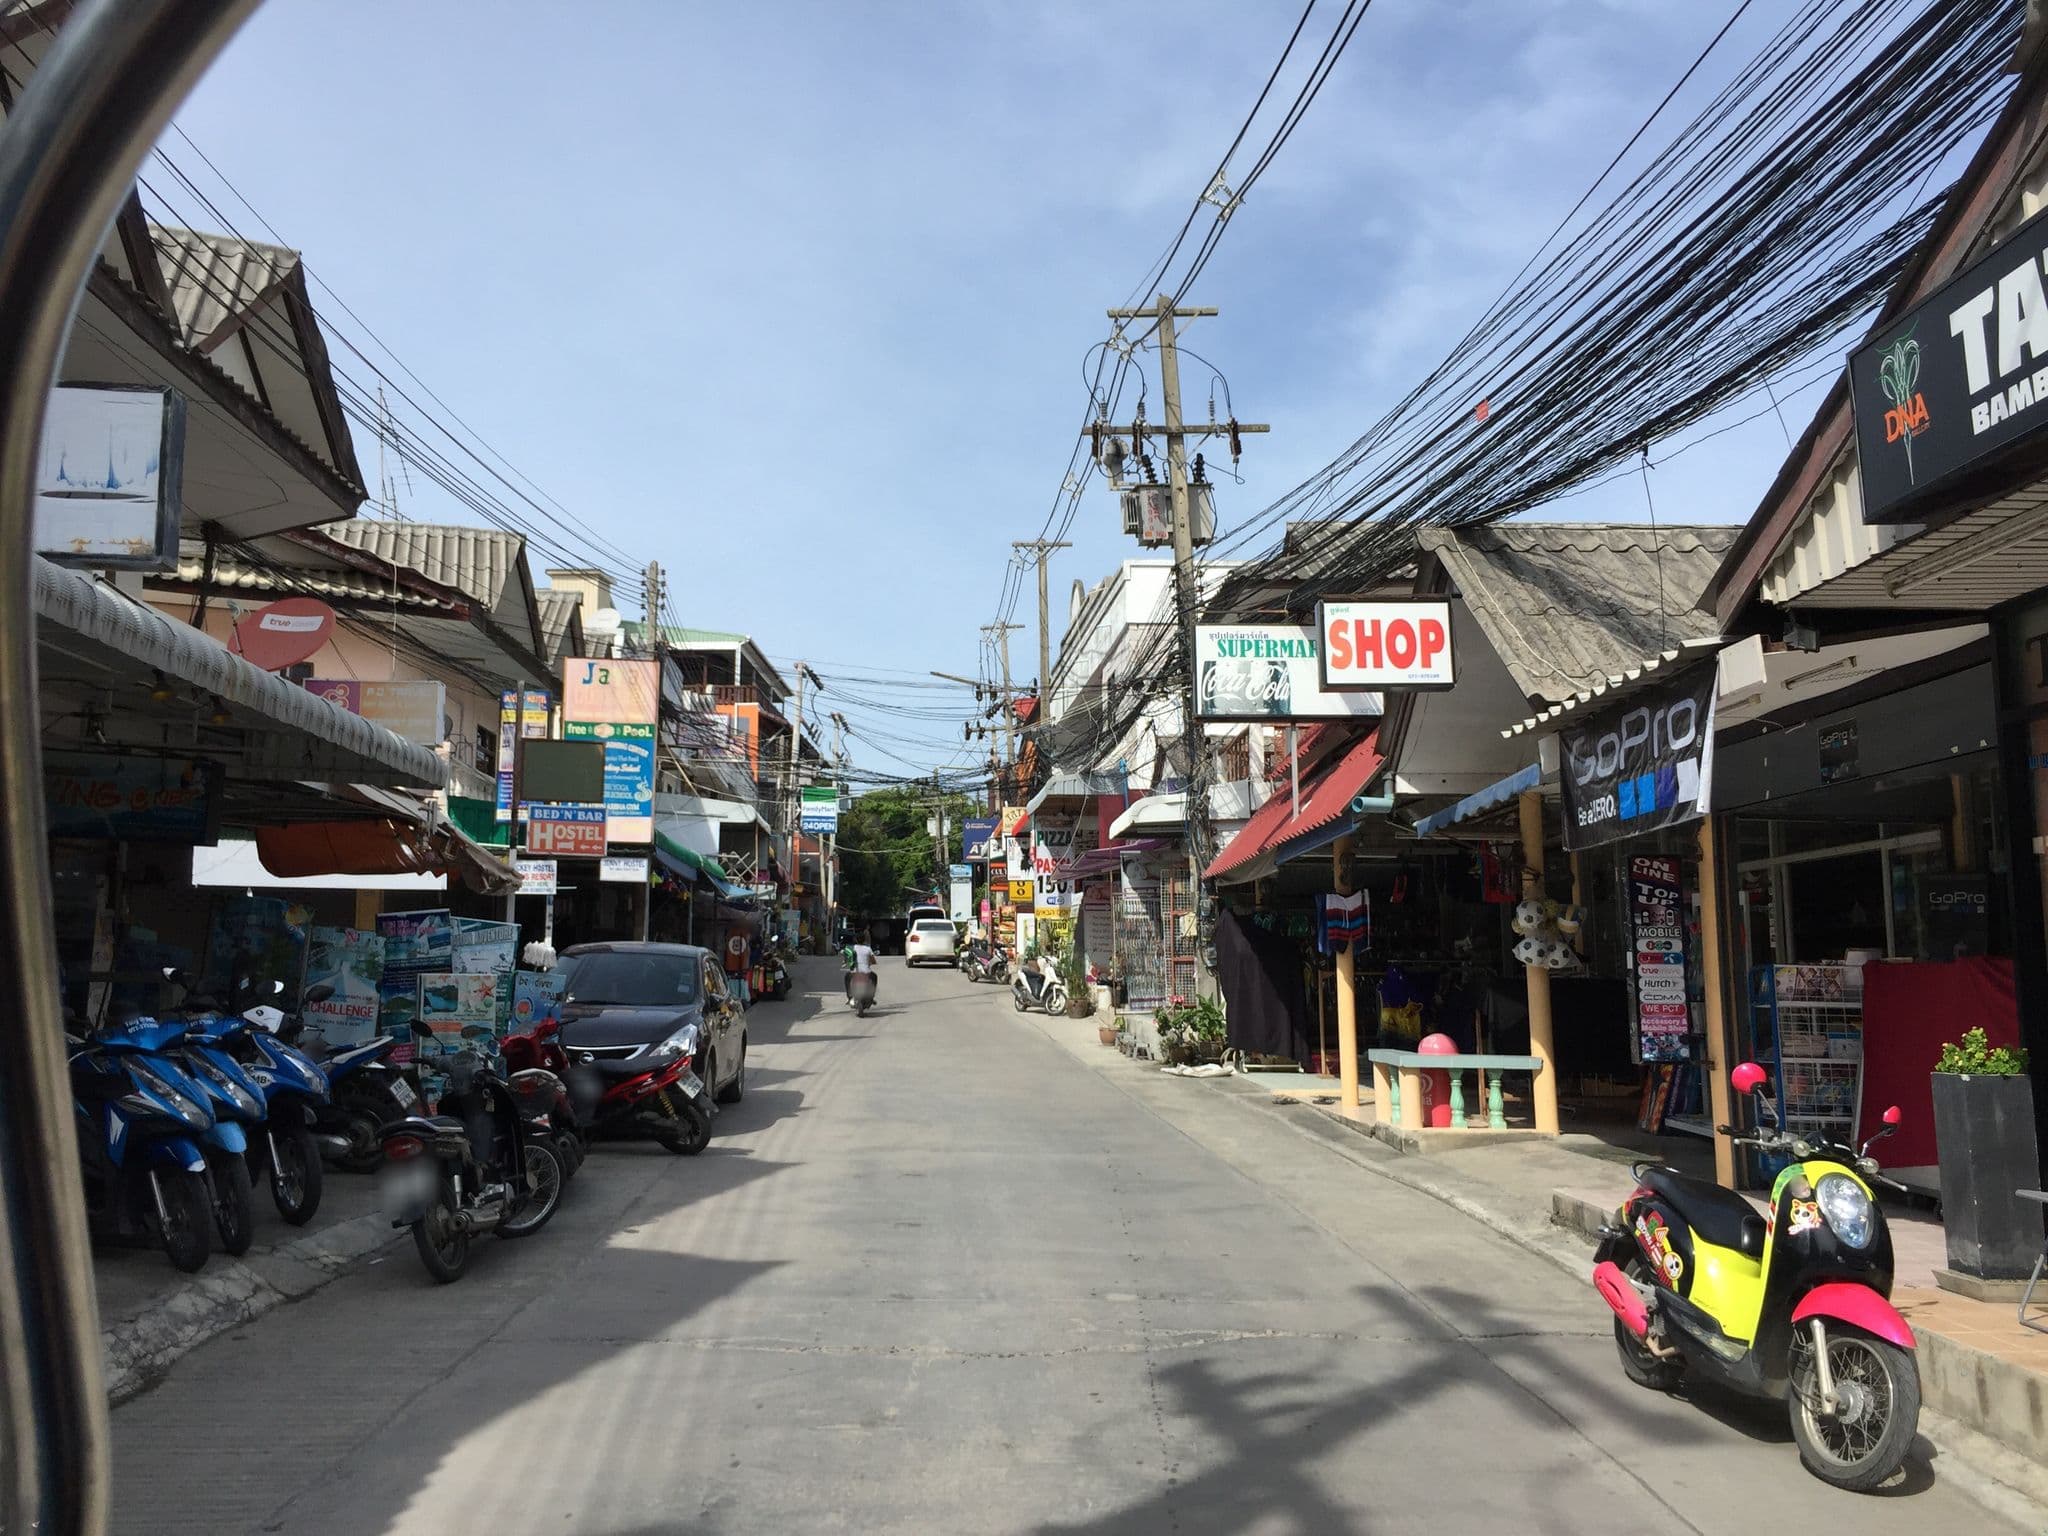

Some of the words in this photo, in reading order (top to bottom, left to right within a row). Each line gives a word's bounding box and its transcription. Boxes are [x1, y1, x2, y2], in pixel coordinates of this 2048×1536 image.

[1949, 248, 2048, 395] TA
[1971, 366, 2048, 436] BAMB
[1884, 393, 1930, 443] DNA
[1329, 619, 1445, 669] SHOP
[567, 723, 587, 736] free
[1819, 730, 1848, 746] GoPro
[1569, 698, 1698, 786] GoPro
[533, 822, 604, 850] HOSTEL
[1036, 830, 1073, 847] PIZZA
[1632, 864, 1675, 882] LINE
[1634, 857, 1670, 872] ON
[1635, 882, 1679, 899] TOP
[1929, 891, 1986, 904] GoPro
[1638, 895, 1674, 906] UP
[1638, 927, 1681, 938] MOBILE
[1644, 979, 1671, 988] Hutch
[310, 1001, 374, 1018] CHALLENGE
